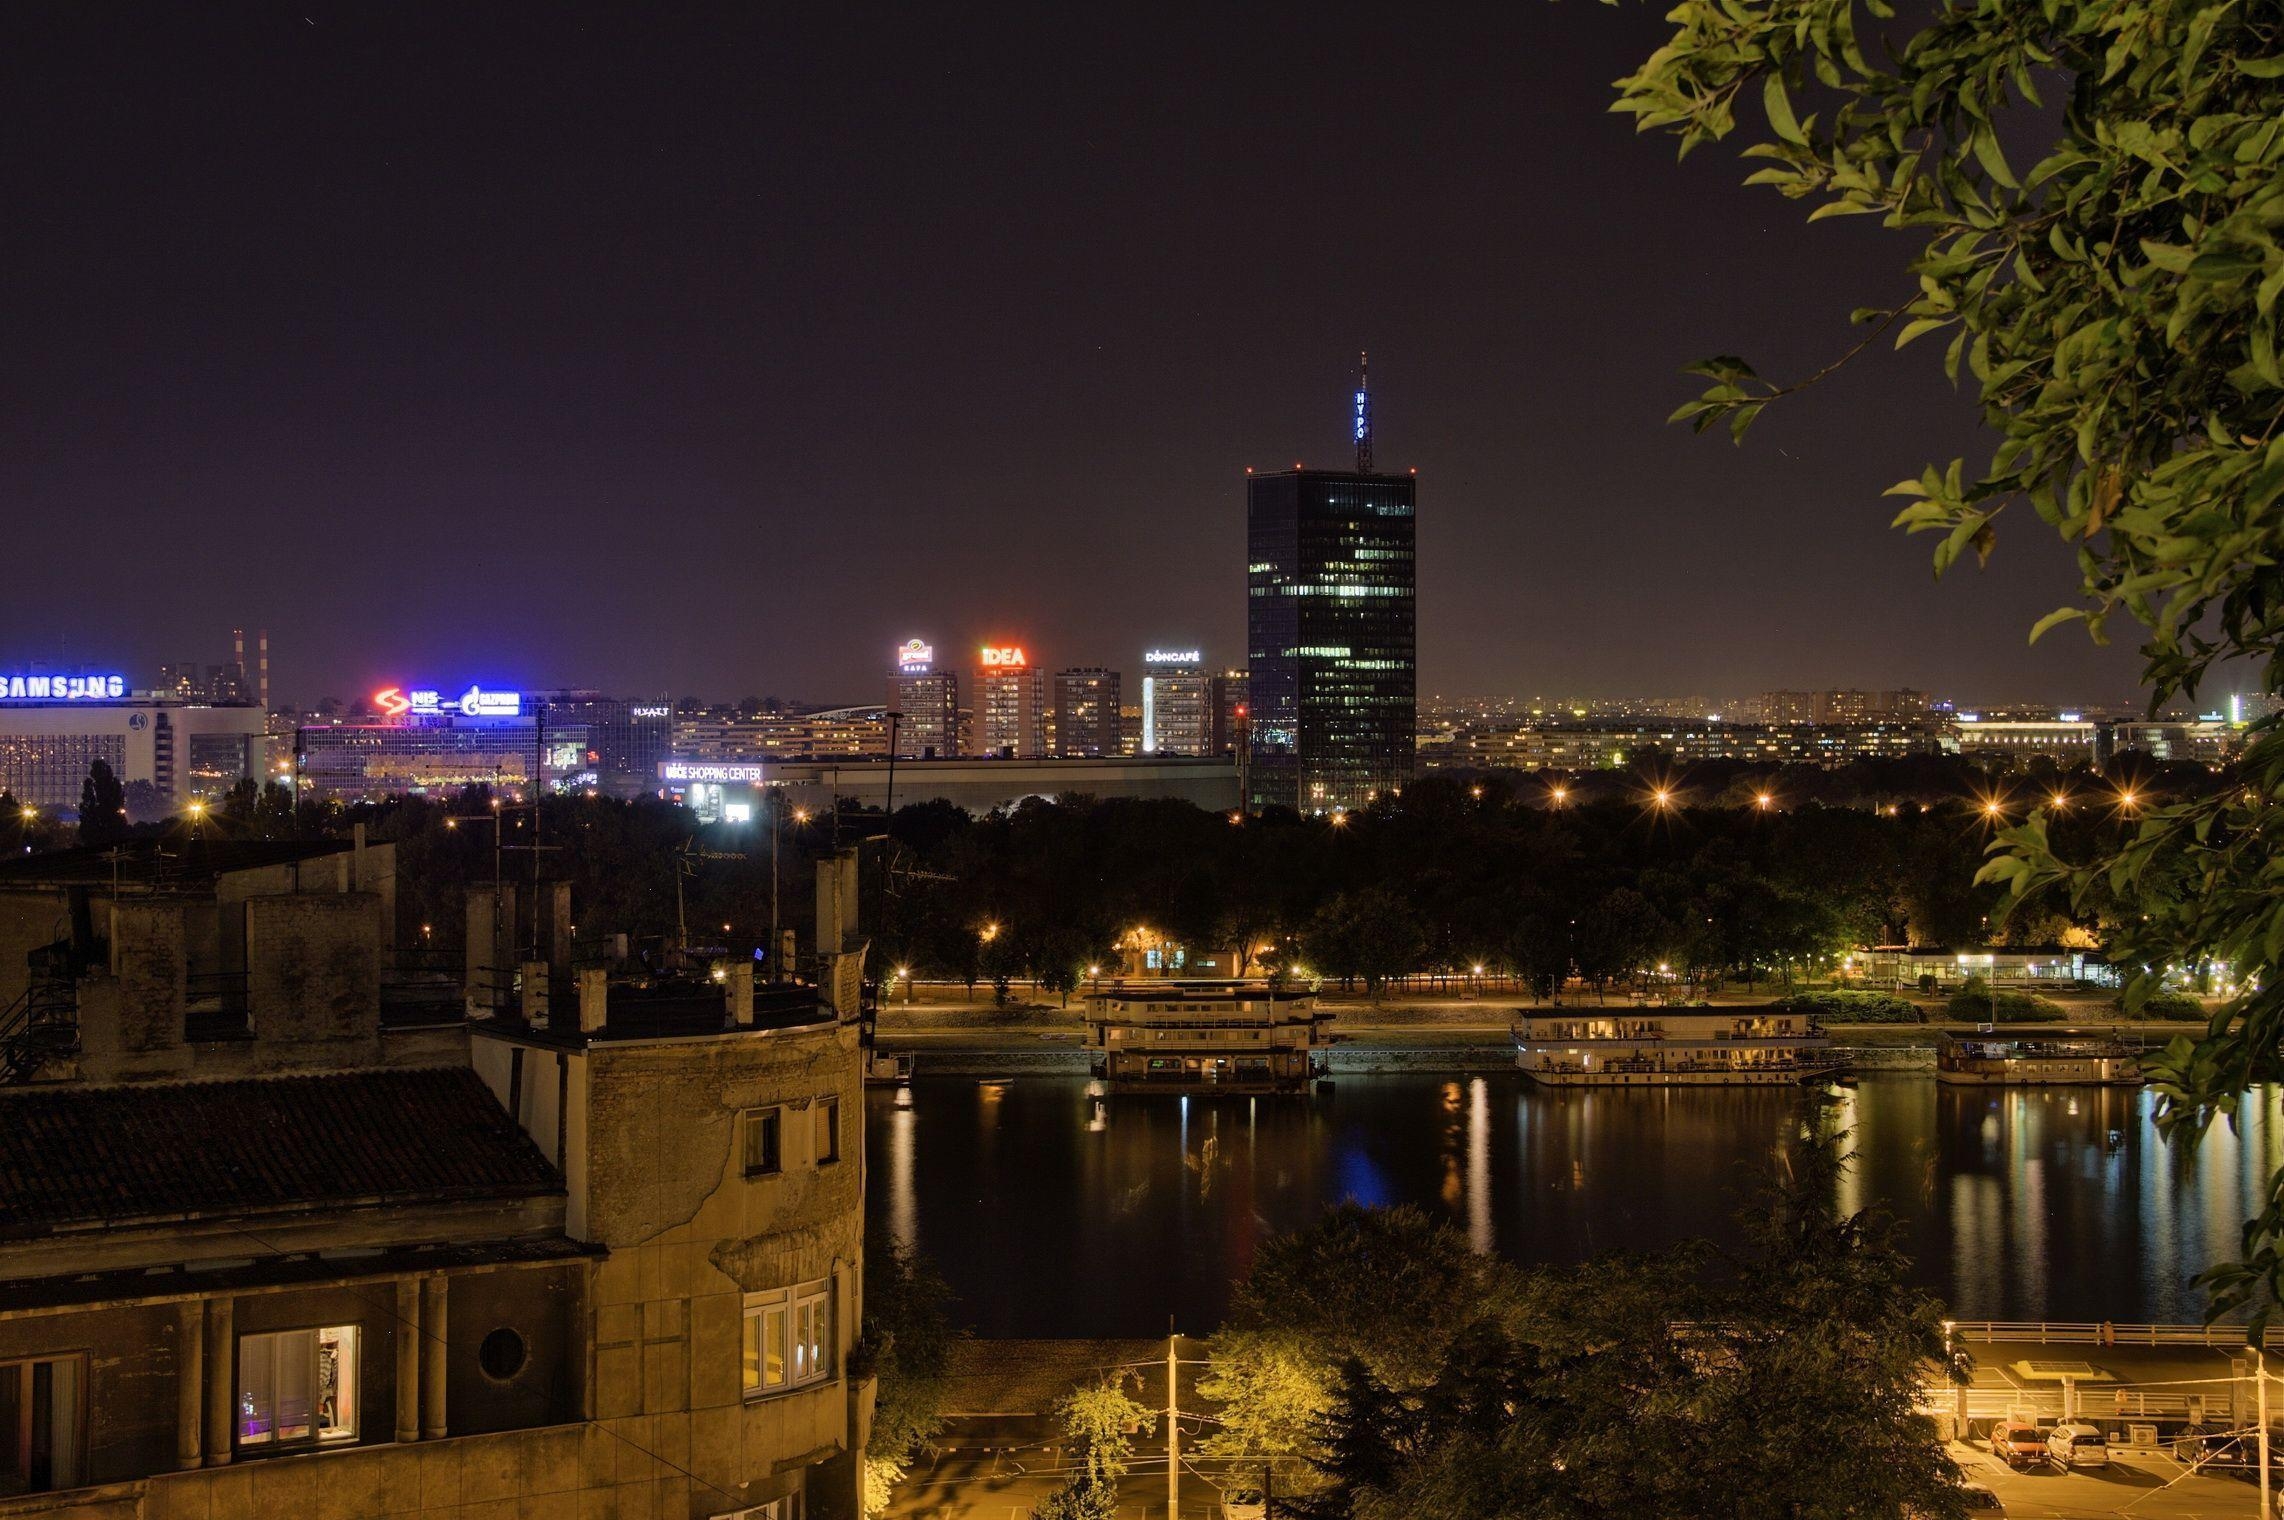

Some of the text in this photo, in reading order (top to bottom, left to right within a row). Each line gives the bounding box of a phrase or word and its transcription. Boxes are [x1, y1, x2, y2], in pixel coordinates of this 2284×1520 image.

[1356, 392, 1365, 439] HYPO
[411, 691, 438, 704] NIS
[633, 707, 669, 717] HYATT
[688, 766, 728, 780] SHOPPING
[729, 767, 761, 781] CENTER
